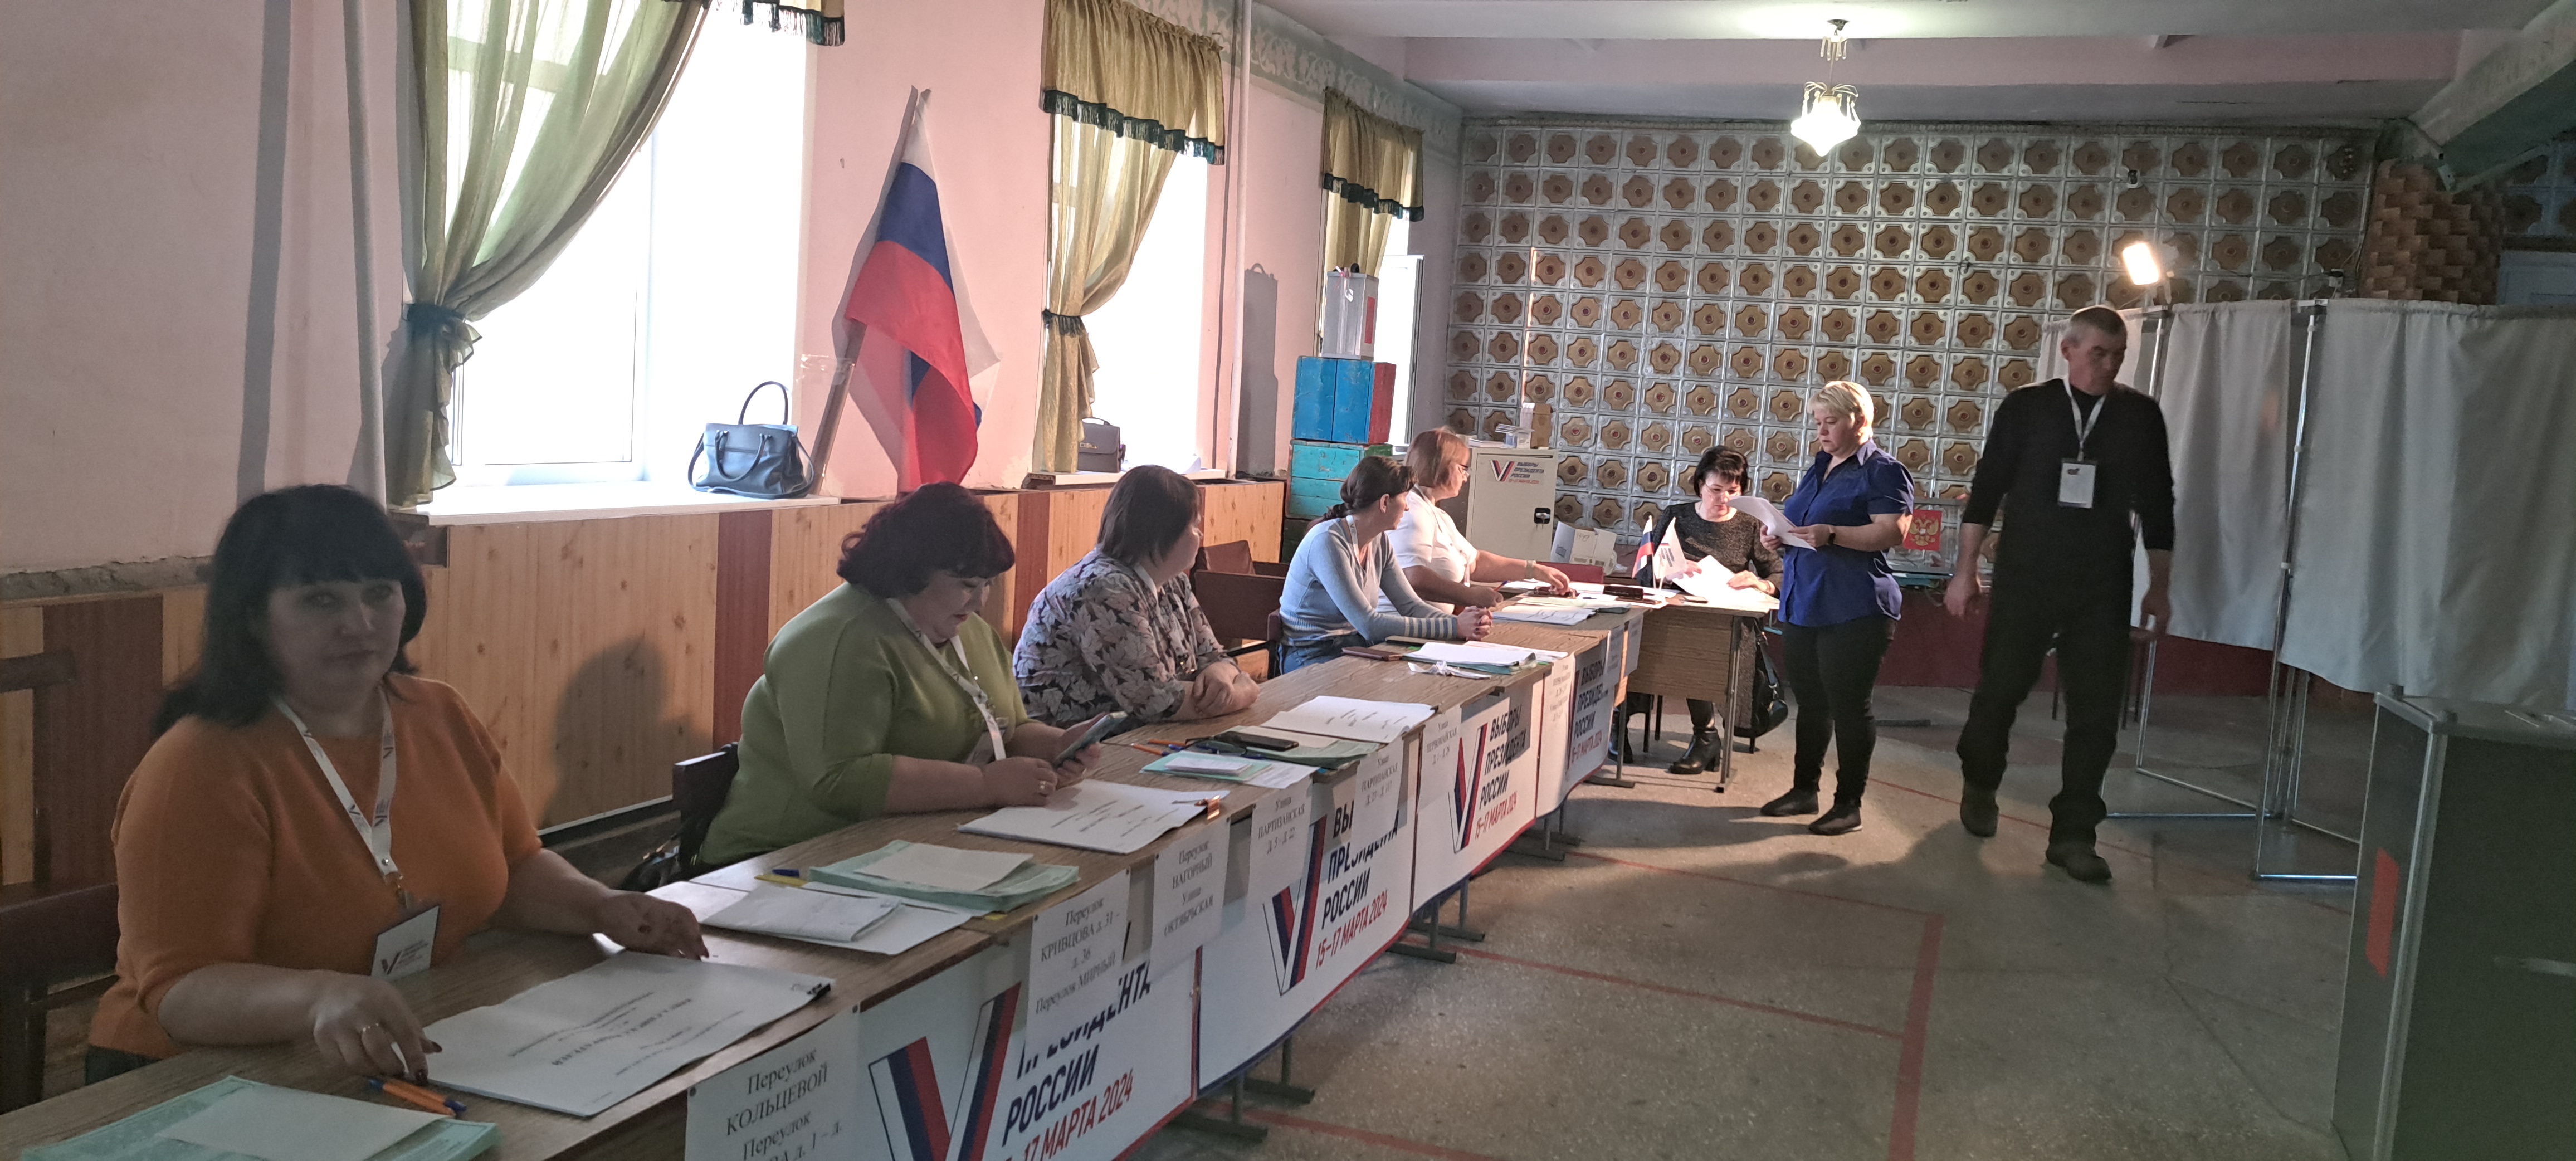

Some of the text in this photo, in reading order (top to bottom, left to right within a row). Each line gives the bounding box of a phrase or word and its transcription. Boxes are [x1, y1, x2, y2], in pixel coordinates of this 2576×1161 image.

[1490, 704, 1522, 742] ВЫБОРЫ
[1485, 729, 1526, 775] ПРЕЗИДЕНТА
[1479, 769, 1510, 810] РОССИИ
[1321, 867, 1370, 930] РОССИИ
[1340, 904, 1369, 949] МАРТА
[1369, 889, 1388, 925] 2024
[1041, 923, 1094, 962] КРИВЦОВА
[747, 1049, 817, 1095] Переулок
[1002, 1044, 1100, 1148] РОССИИ
[726, 1061, 828, 1136] КОЛЬЦЕВОЙ
[1040, 1095, 1097, 1161] МАРТА
[1097, 1068, 1134, 1124] 2024
[743, 1111, 812, 1161] Переулок
